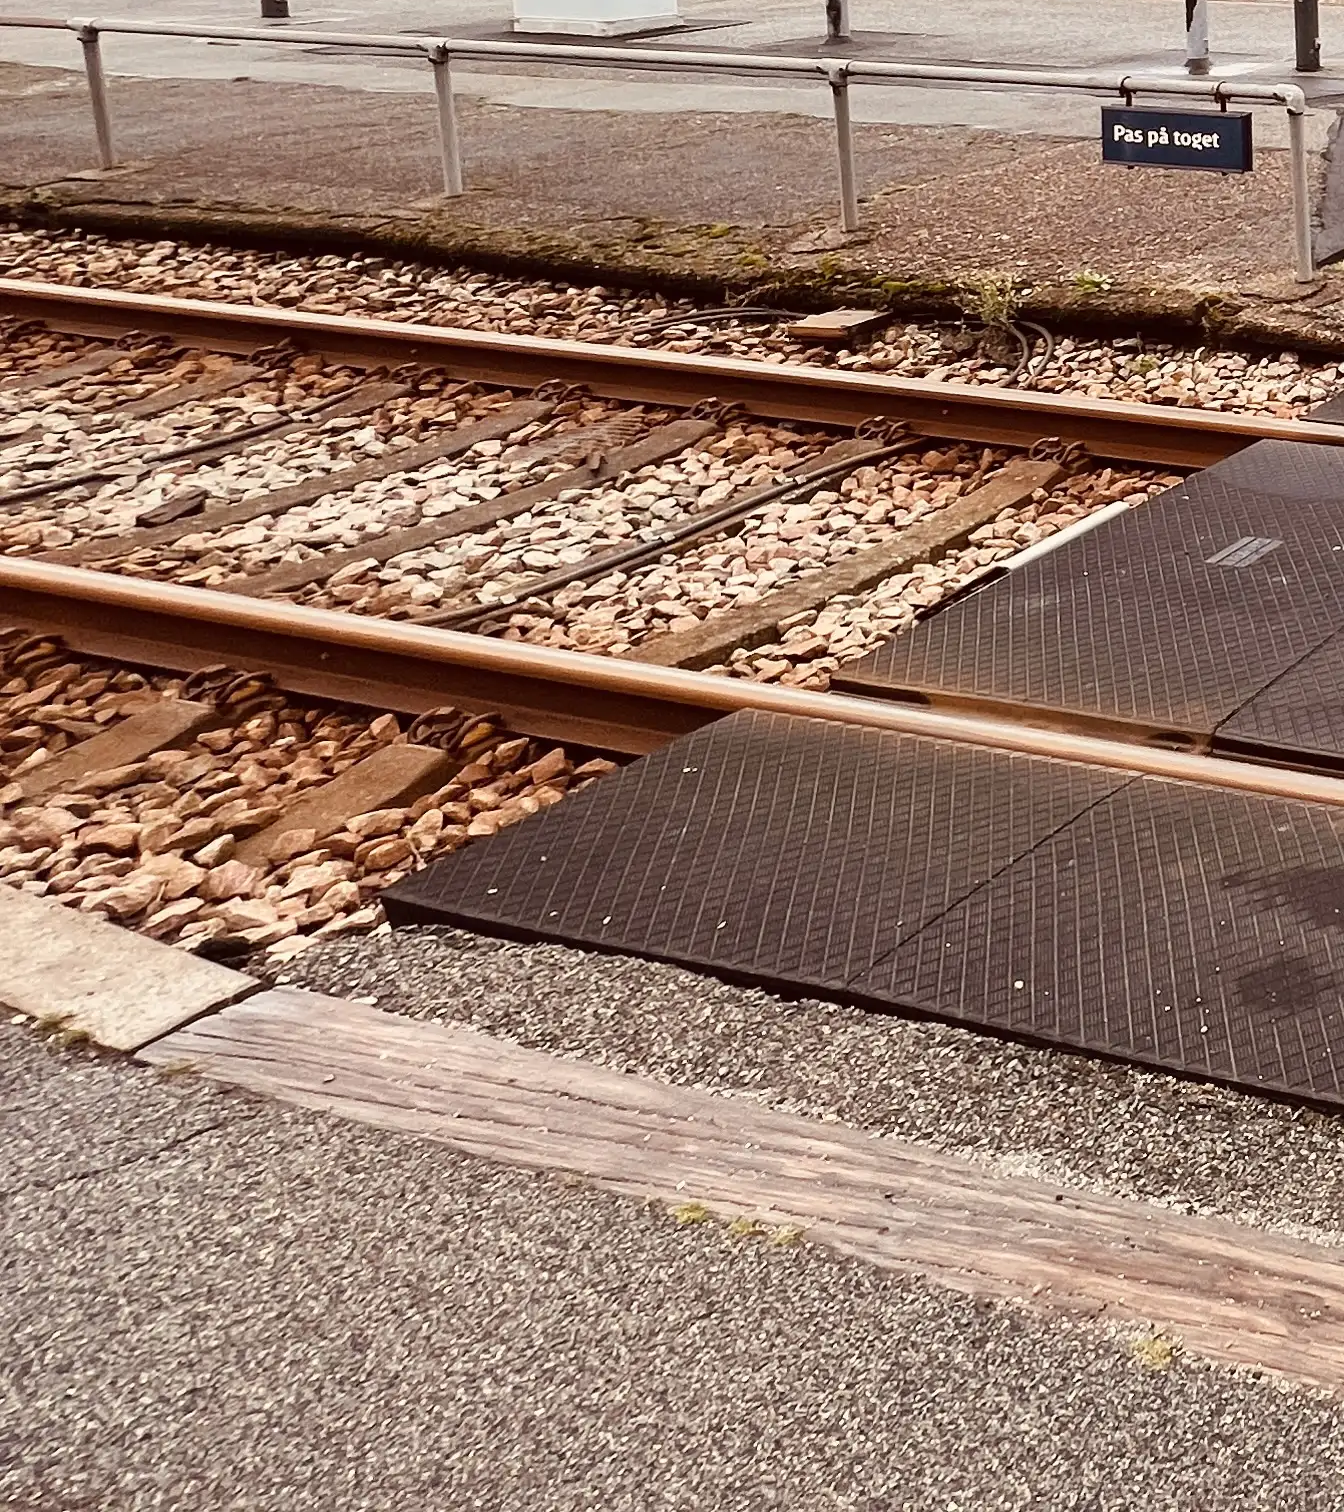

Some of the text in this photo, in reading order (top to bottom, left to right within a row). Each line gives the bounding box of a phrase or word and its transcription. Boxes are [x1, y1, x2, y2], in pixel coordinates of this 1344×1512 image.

[1113, 124, 1220, 151] Pas på toget
